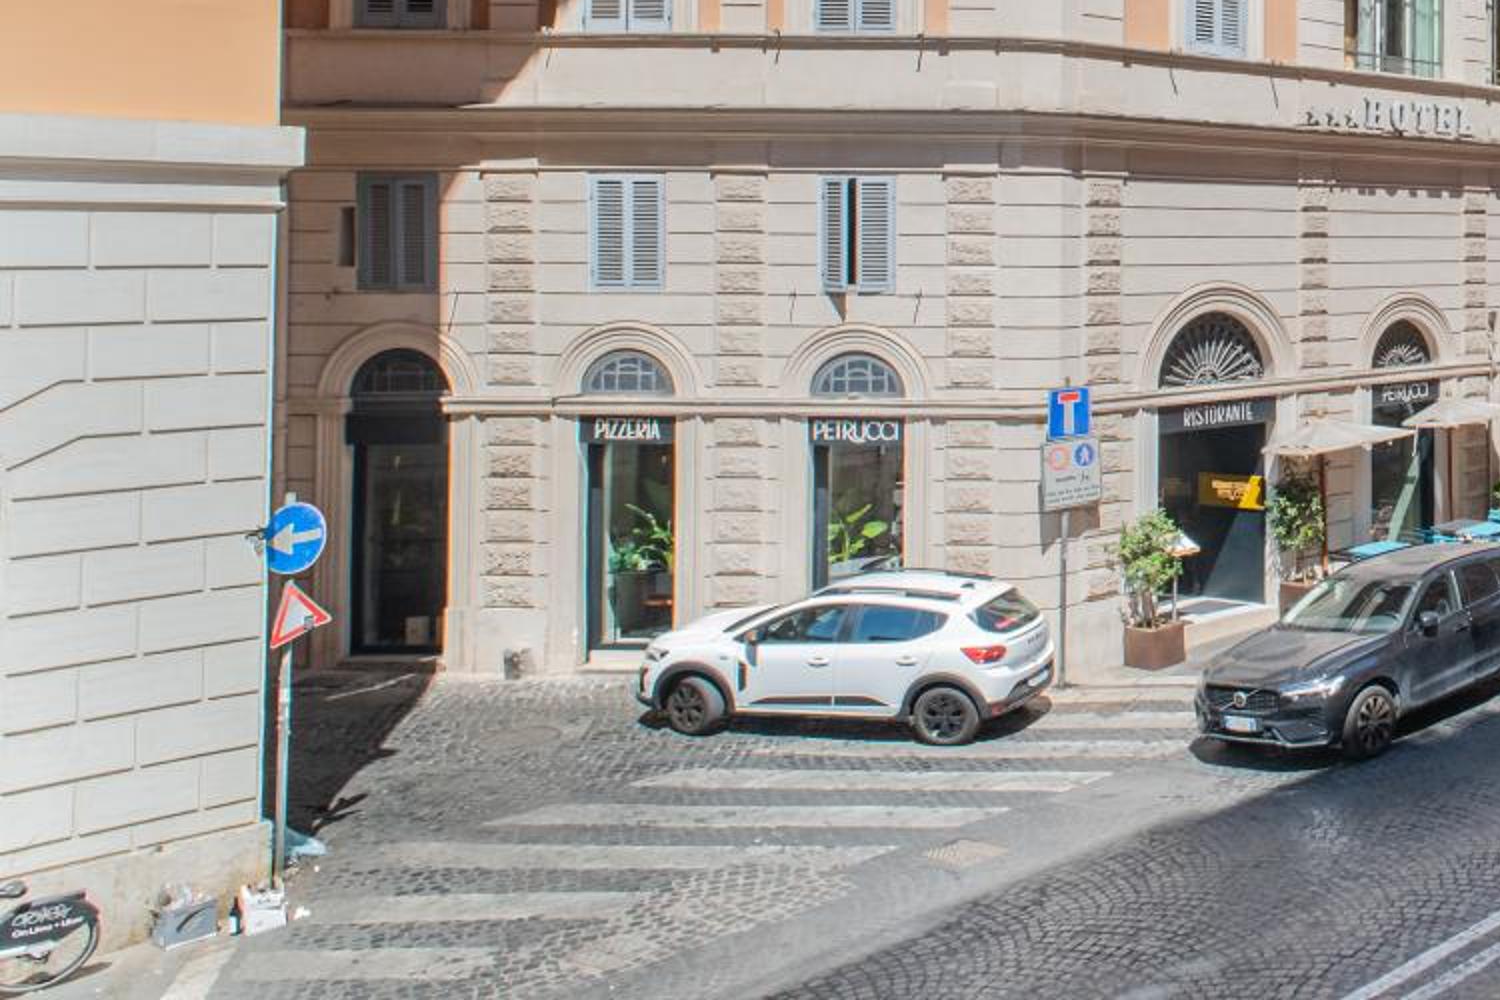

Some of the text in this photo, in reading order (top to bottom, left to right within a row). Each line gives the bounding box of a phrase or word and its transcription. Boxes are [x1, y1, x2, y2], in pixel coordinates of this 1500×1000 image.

[1362, 97, 1474, 139] HOTEL
[1183, 402, 1254, 427] RISTORANTE
[594, 418, 661, 440] PIZZERIA
[813, 421, 899, 443] PETRUCCI
